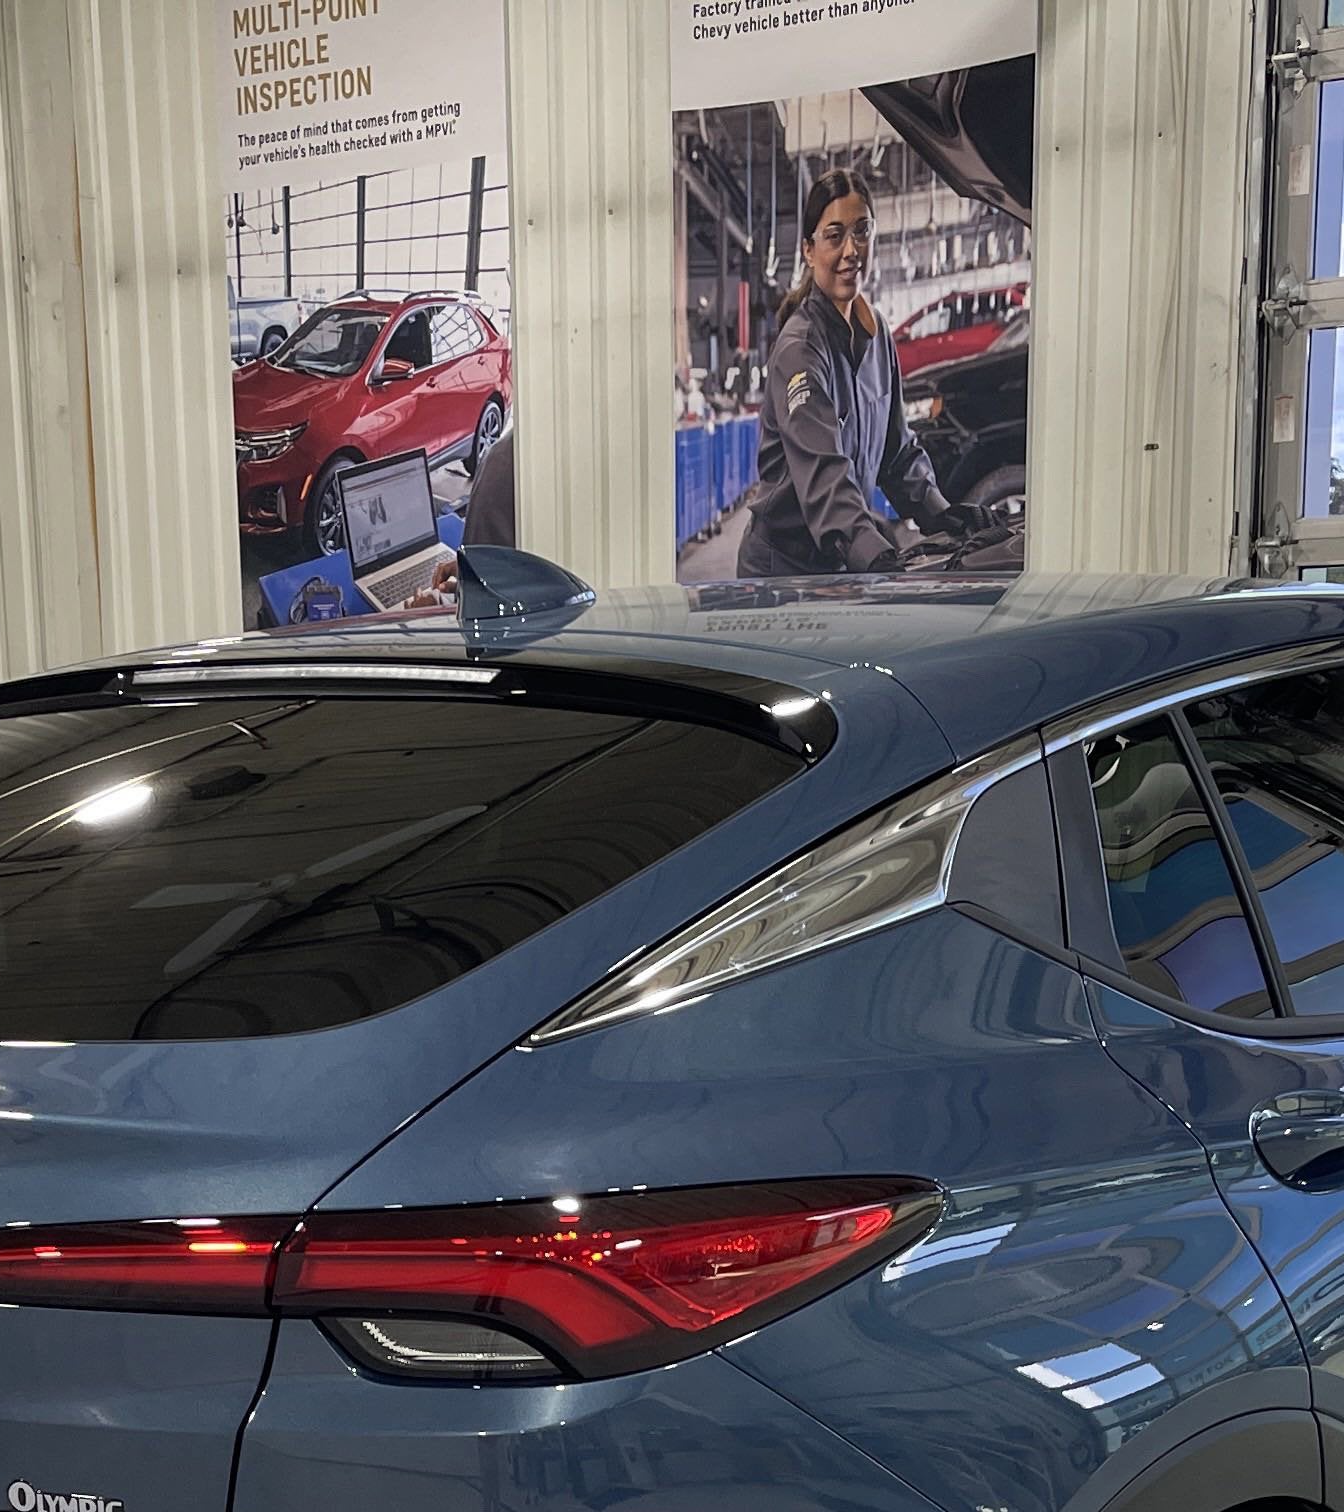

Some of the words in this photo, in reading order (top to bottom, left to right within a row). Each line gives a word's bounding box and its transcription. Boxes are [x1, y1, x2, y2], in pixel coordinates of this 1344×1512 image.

[693, 0, 742, 19] Factory
[693, 23, 732, 40] Chevy
[734, 13, 780, 35] vehicle
[783, 8, 825, 27] better
[828, 1, 858, 19] than
[233, 33, 330, 77] VEHICLE
[236, 65, 372, 116] INSPECTION
[237, 133, 256, 148] The
[258, 130, 288, 149] peace
[290, 124, 301, 140] of
[303, 120, 329, 138] mind
[331, 118, 353, 134] that
[355, 114, 390, 131] comes
[392, 109, 418, 124] from
[421, 101, 461, 123] getting
[238, 153, 261, 171] your
[263, 143, 306, 163] vehicle's
[308, 139, 341, 157] health
[343, 131, 387, 152] checked
[389, 127, 414, 145] with
[416, 129, 423, 141] a
